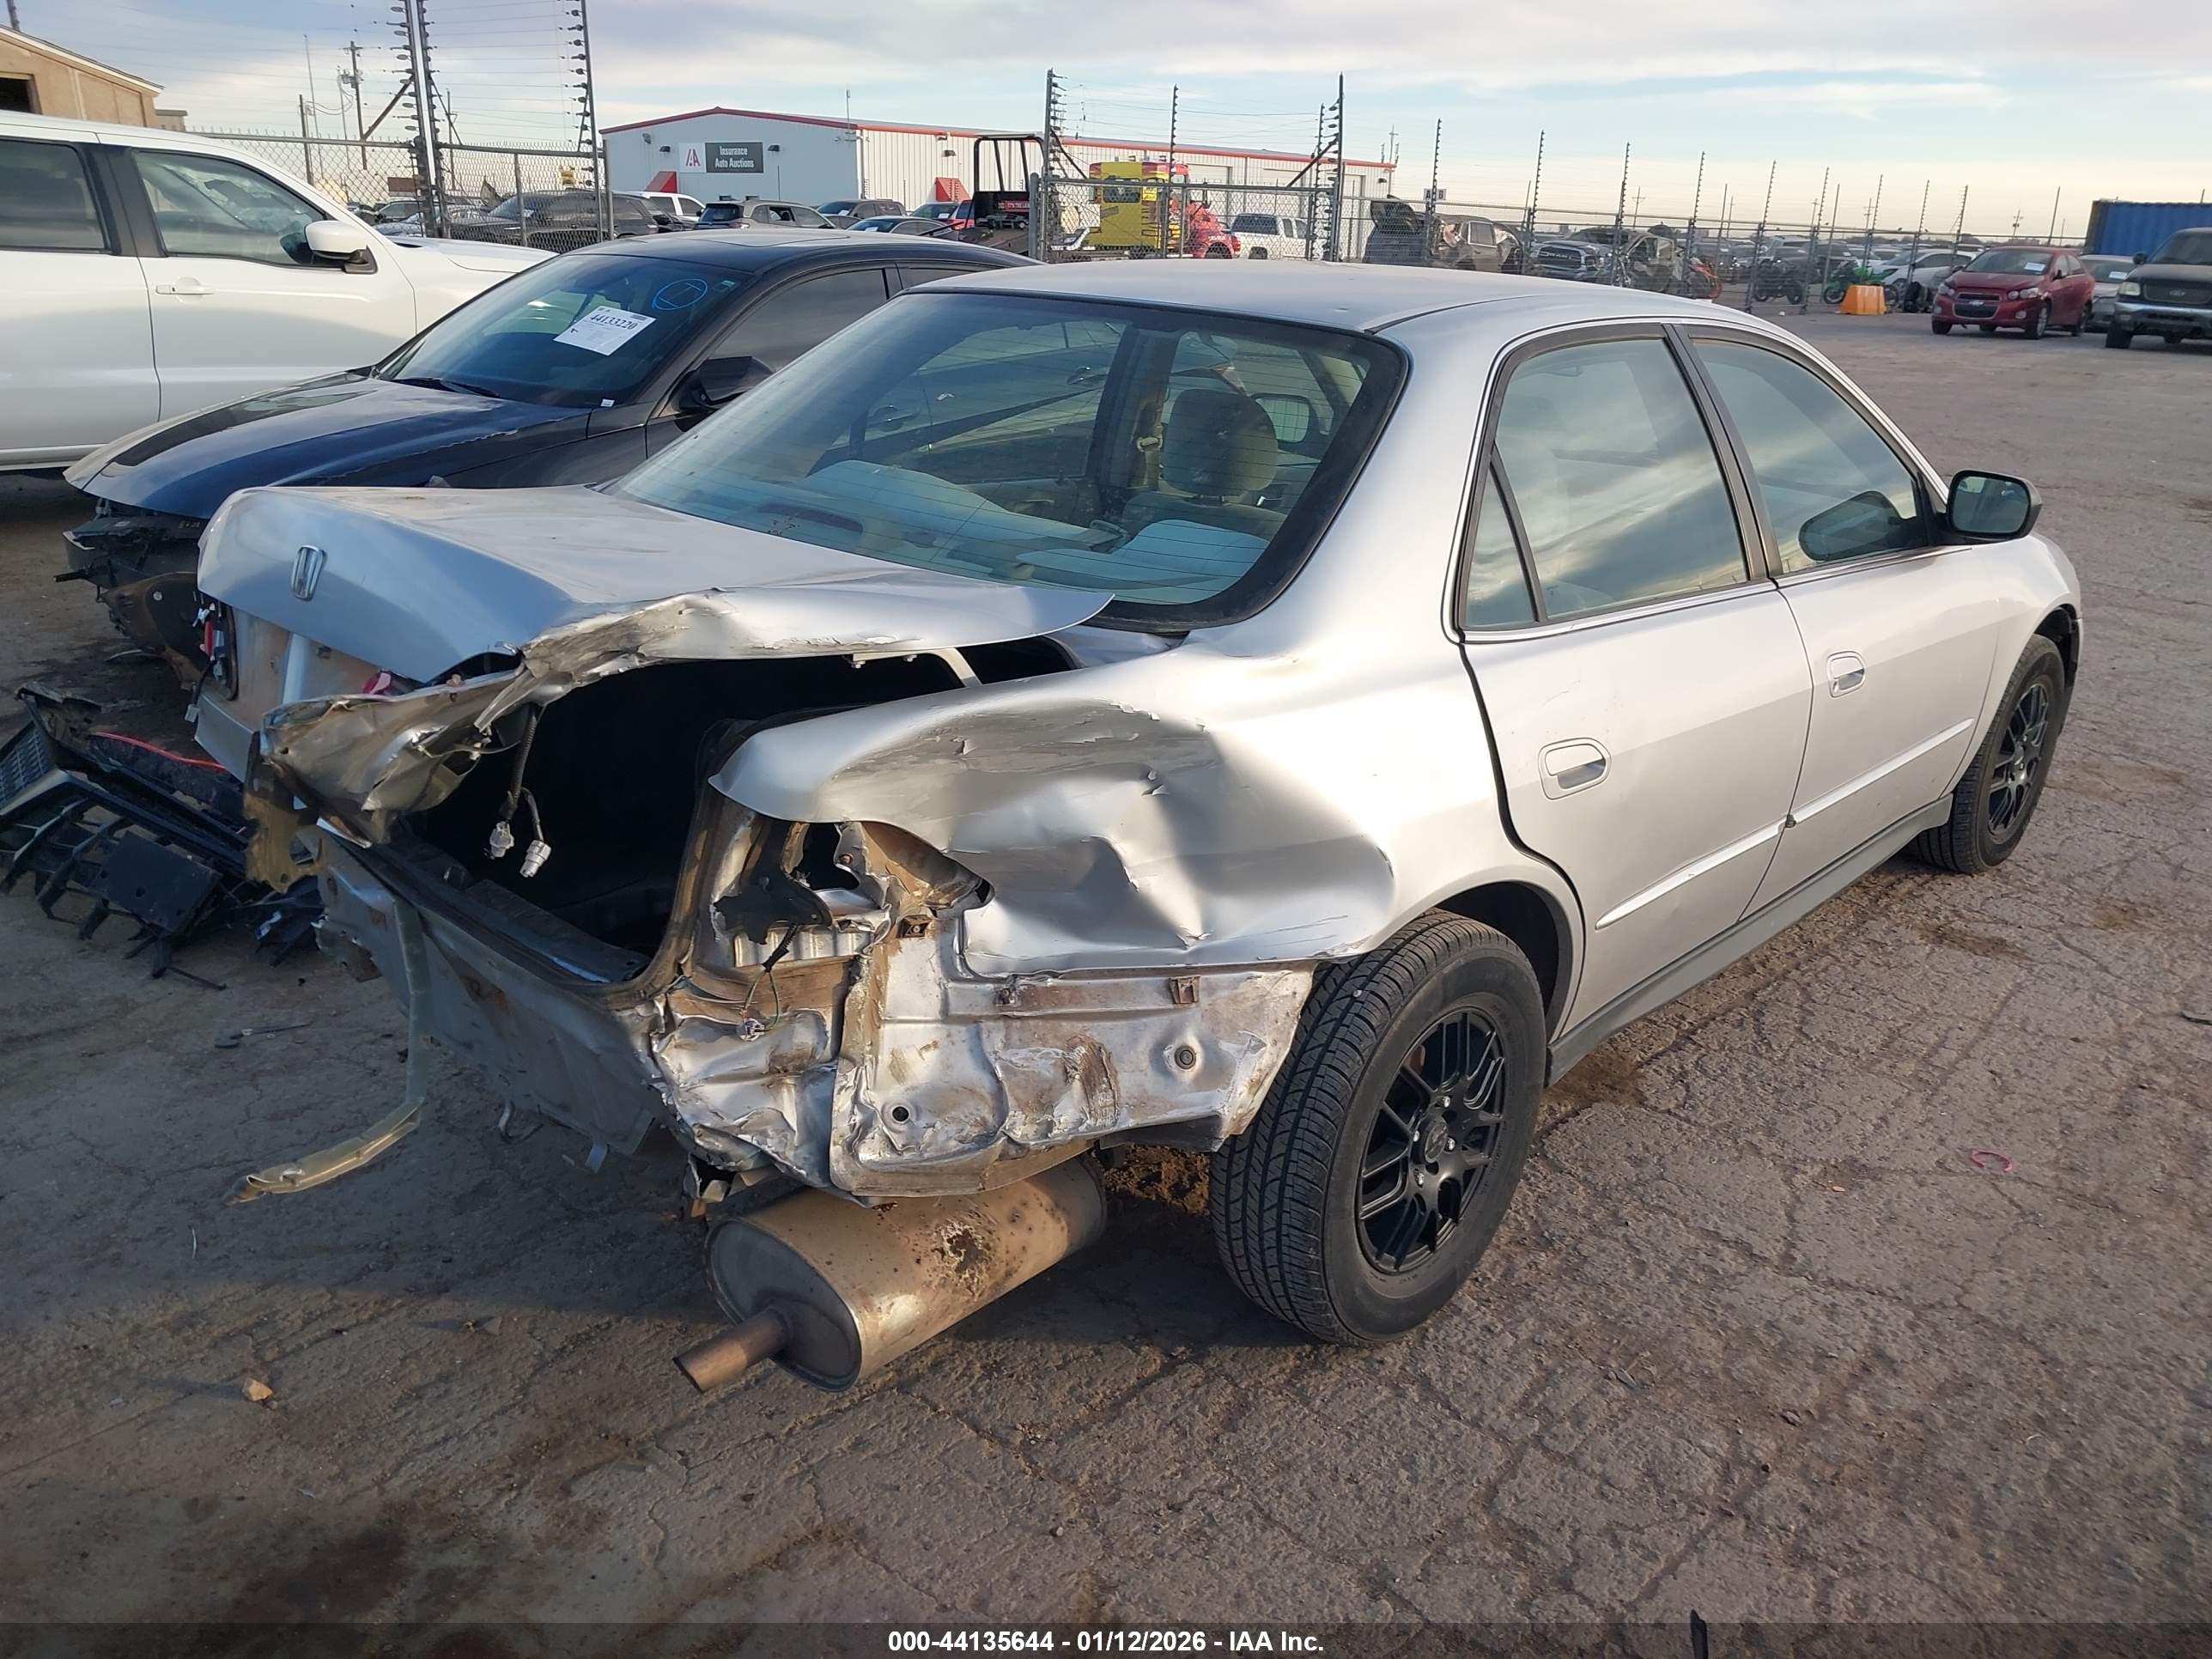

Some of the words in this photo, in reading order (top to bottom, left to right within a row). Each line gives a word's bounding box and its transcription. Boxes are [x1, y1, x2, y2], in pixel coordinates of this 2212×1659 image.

[720, 146, 748, 155] Insurance
[714, 158, 728, 168] Auto
[730, 158, 754, 168] Auctions
[590, 315, 637, 330] 44133220
